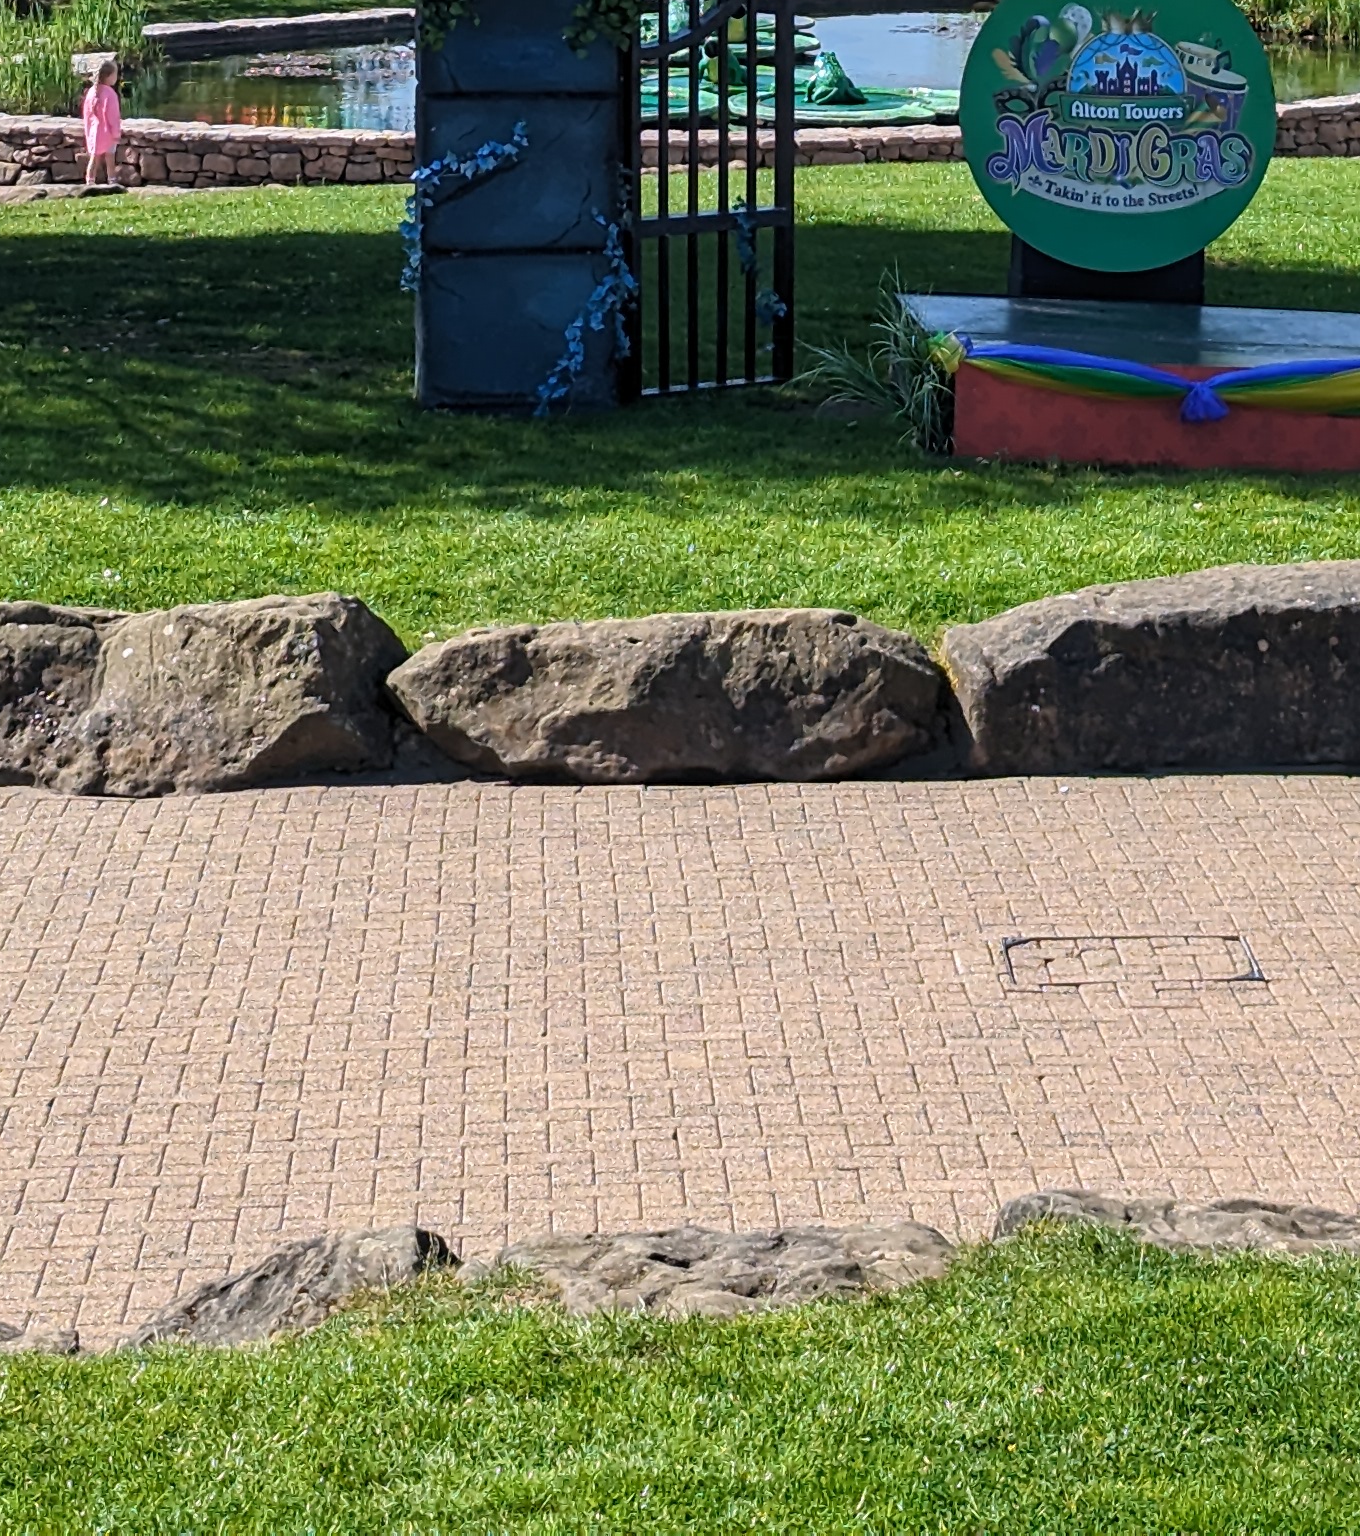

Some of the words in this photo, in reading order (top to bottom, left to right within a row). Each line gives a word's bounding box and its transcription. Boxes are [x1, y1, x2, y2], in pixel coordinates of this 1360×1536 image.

[1071, 101, 1120, 119] Alton
[1121, 103, 1184, 120] Towers
[987, 111, 1132, 190] MARDI
[1137, 124, 1252, 187] GRAS
[1044, 179, 1089, 203] Takin'
[1091, 192, 1102, 206] it
[1106, 195, 1120, 207] to
[1123, 194, 1144, 207] the
[1148, 184, 1200, 206] Streets!
